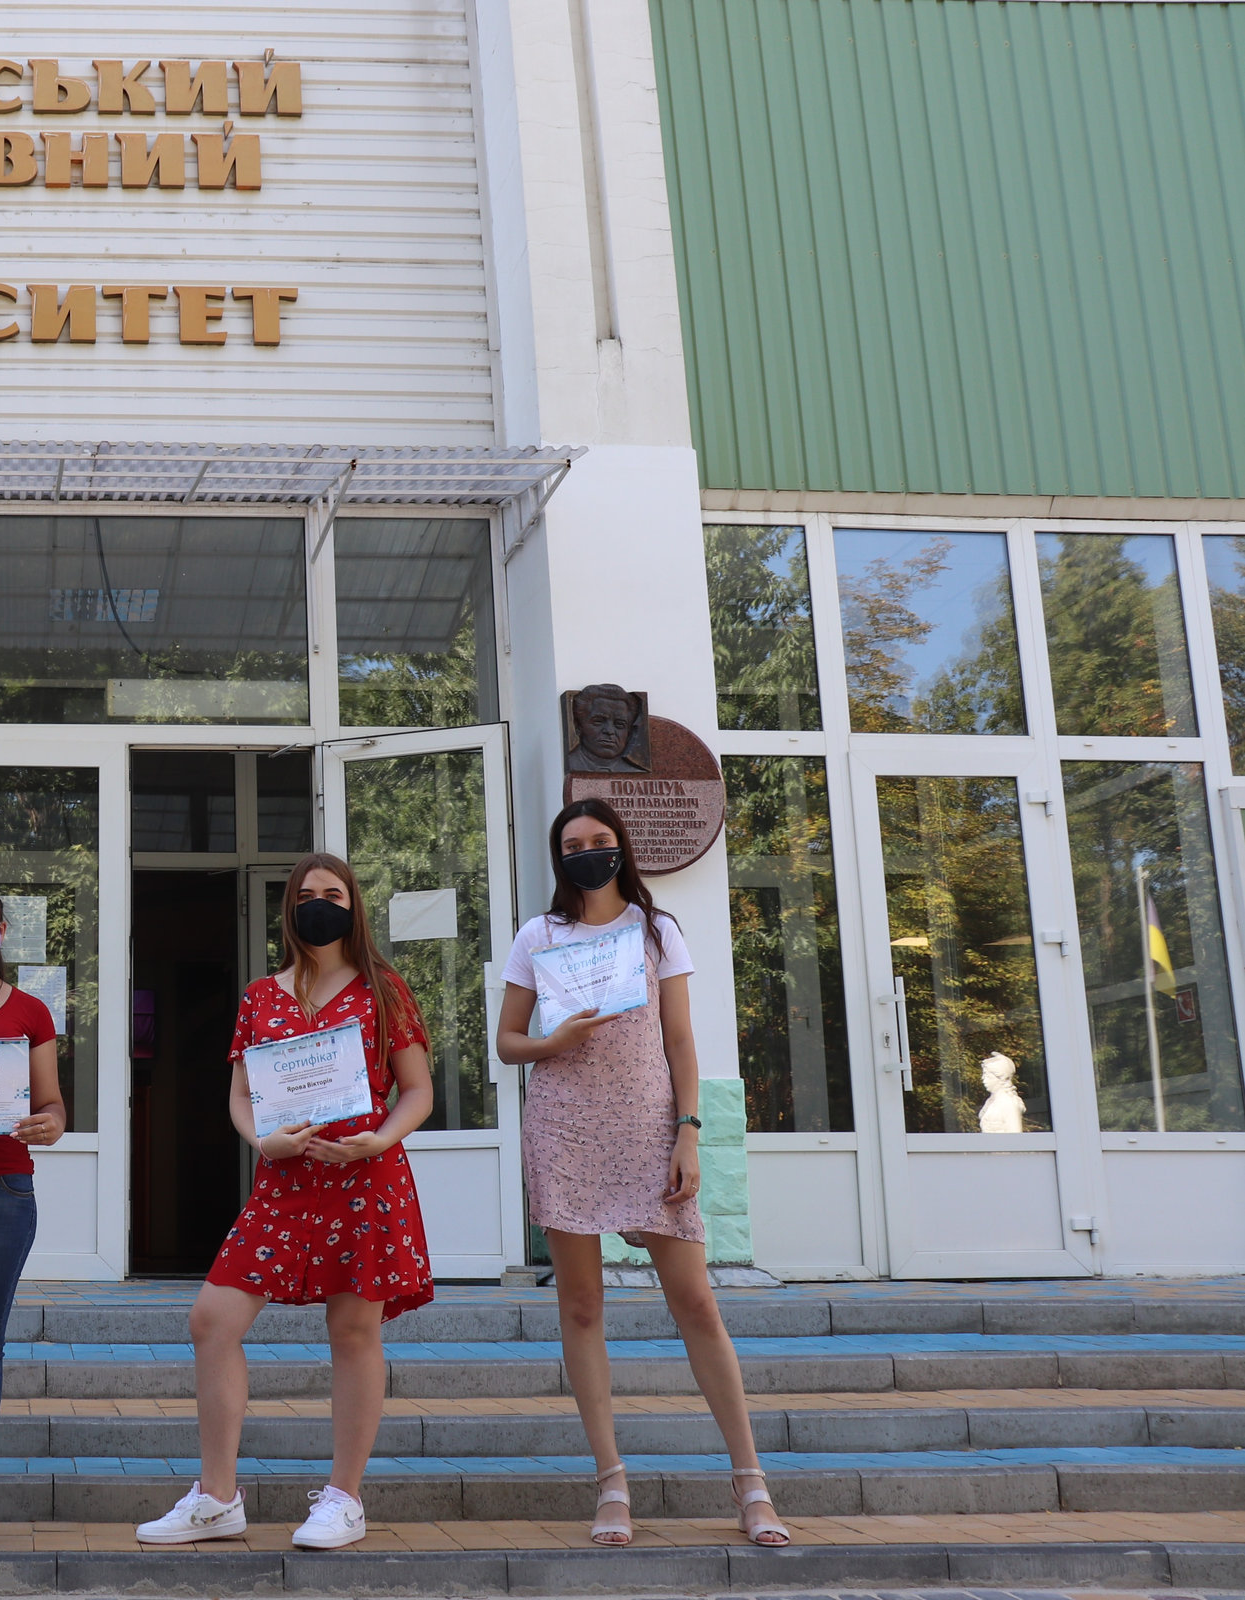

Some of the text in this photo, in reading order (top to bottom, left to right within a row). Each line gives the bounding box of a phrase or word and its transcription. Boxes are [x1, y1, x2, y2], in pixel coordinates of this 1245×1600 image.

[611, 781, 686, 796] ПОЛІЩУК
[604, 797, 699, 808] ВГЕН ПАВЛОВИЧ
[634, 810, 696, 819] ХЕРСОНСЬКОГО
[636, 855, 681, 863] ІВЕРСИТЕТУ
[560, 950, 618, 974] Сертифікат
[274, 1051, 338, 1073] Сертифікат
[287, 1085, 307, 1093] Ярова
[307, 1077, 333, 1088] Вікторія
